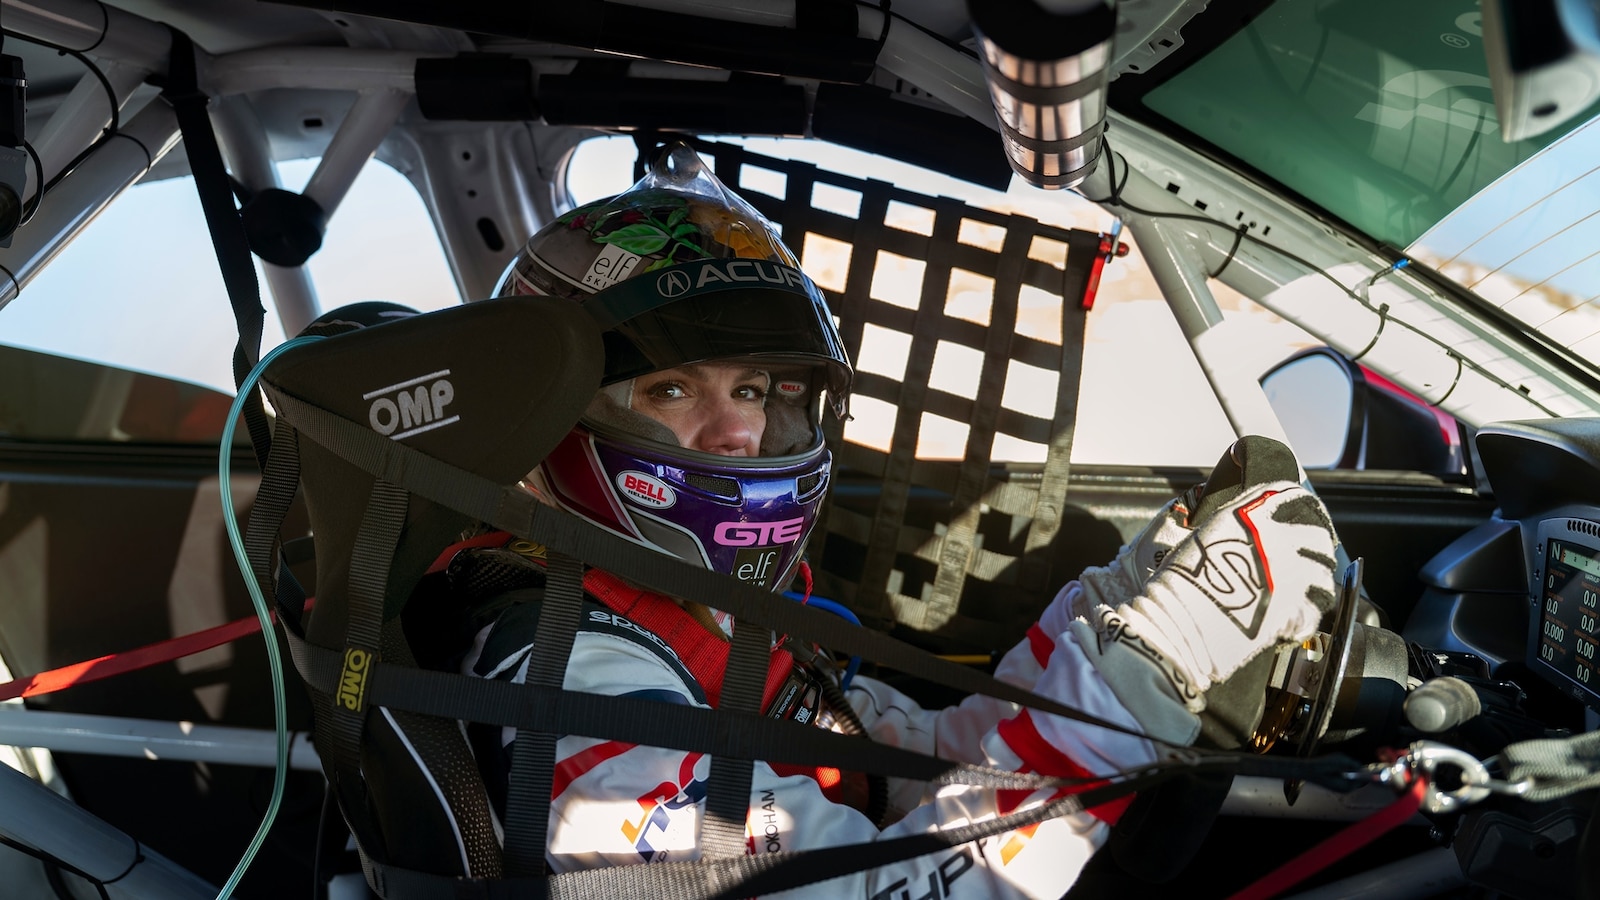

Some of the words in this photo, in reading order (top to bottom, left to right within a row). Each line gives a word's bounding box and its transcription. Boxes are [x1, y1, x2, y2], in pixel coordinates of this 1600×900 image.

[369, 380, 454, 436] OMP
[624, 474, 667, 502] BELL
[628, 489, 661, 505] HELMETS
[1551, 542, 1561, 560] N
[1548, 574, 1554, 588] 0
[1546, 598, 1558, 614] 0.0
[1583, 590, 1597, 608] 0.0
[1544, 621, 1564, 642] 0.000
[1581, 615, 1594, 633] 0.0
[1542, 644, 1553, 661] 0.0
[1577, 638, 1594, 659] 0.00
[341, 649, 366, 711] OMP
[1577, 664, 1590, 683] 0.0
[797, 707, 810, 723] OMP
